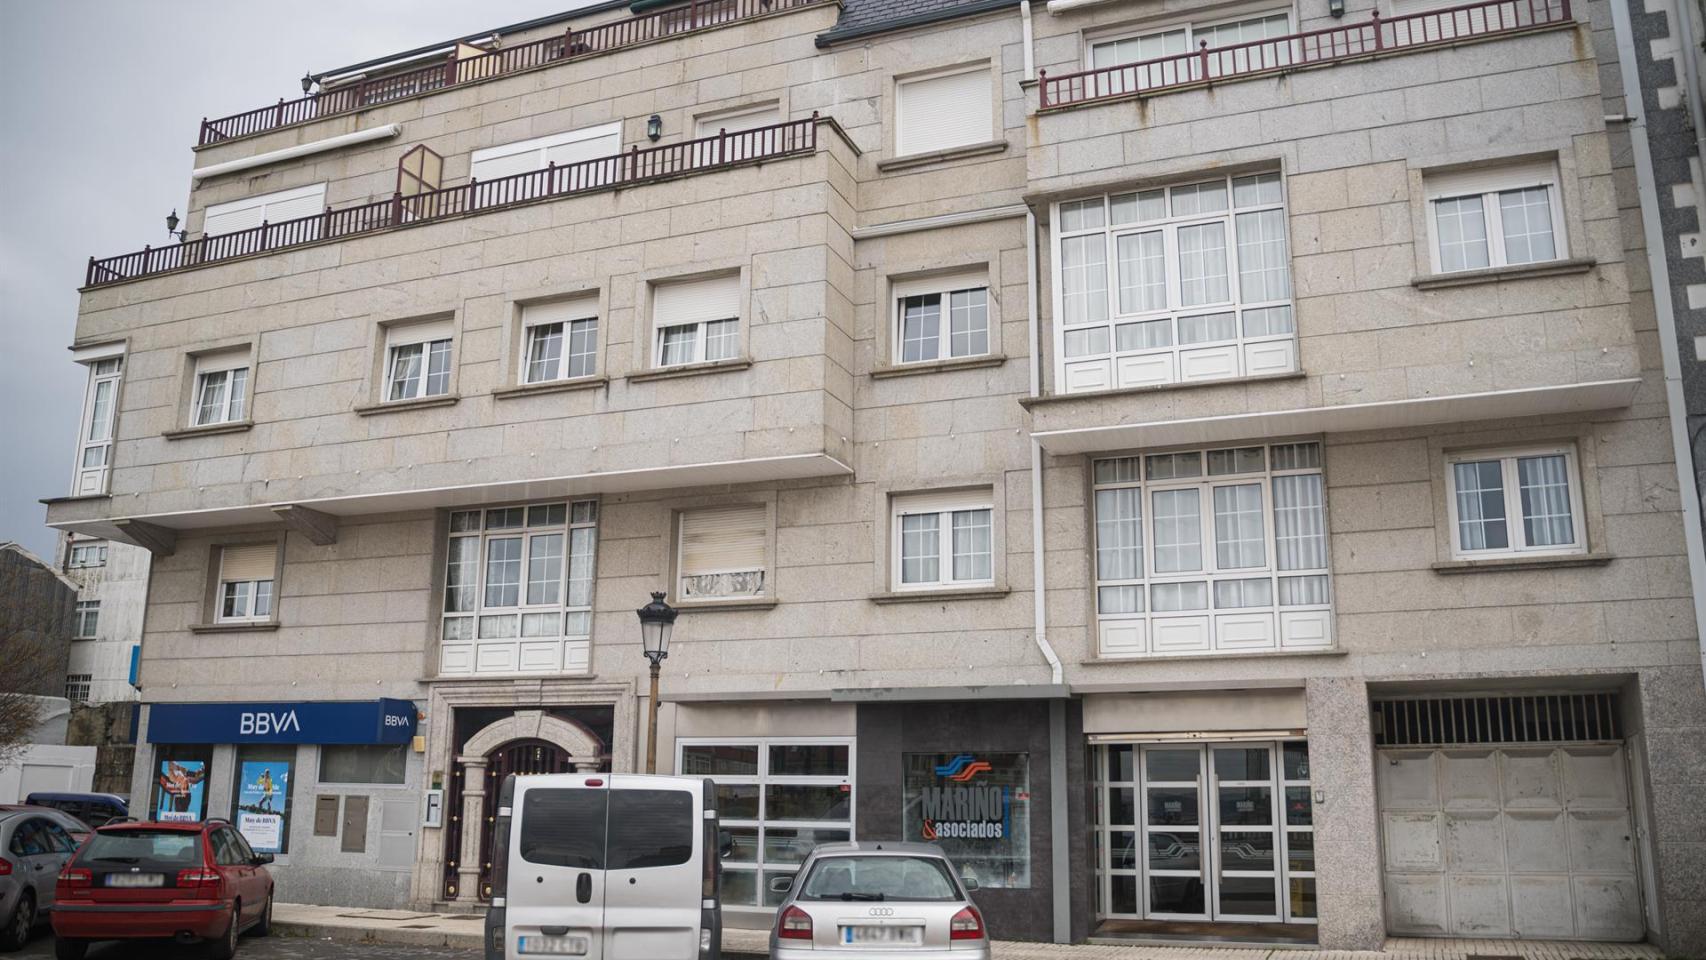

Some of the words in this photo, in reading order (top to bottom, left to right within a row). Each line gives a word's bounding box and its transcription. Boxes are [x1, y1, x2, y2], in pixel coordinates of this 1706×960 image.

[240, 710, 300, 735] BBVA
[384, 715, 409, 727] BBVA
[921, 781, 1003, 821] MARIÑO
[922, 819, 1003, 839] &asociados
